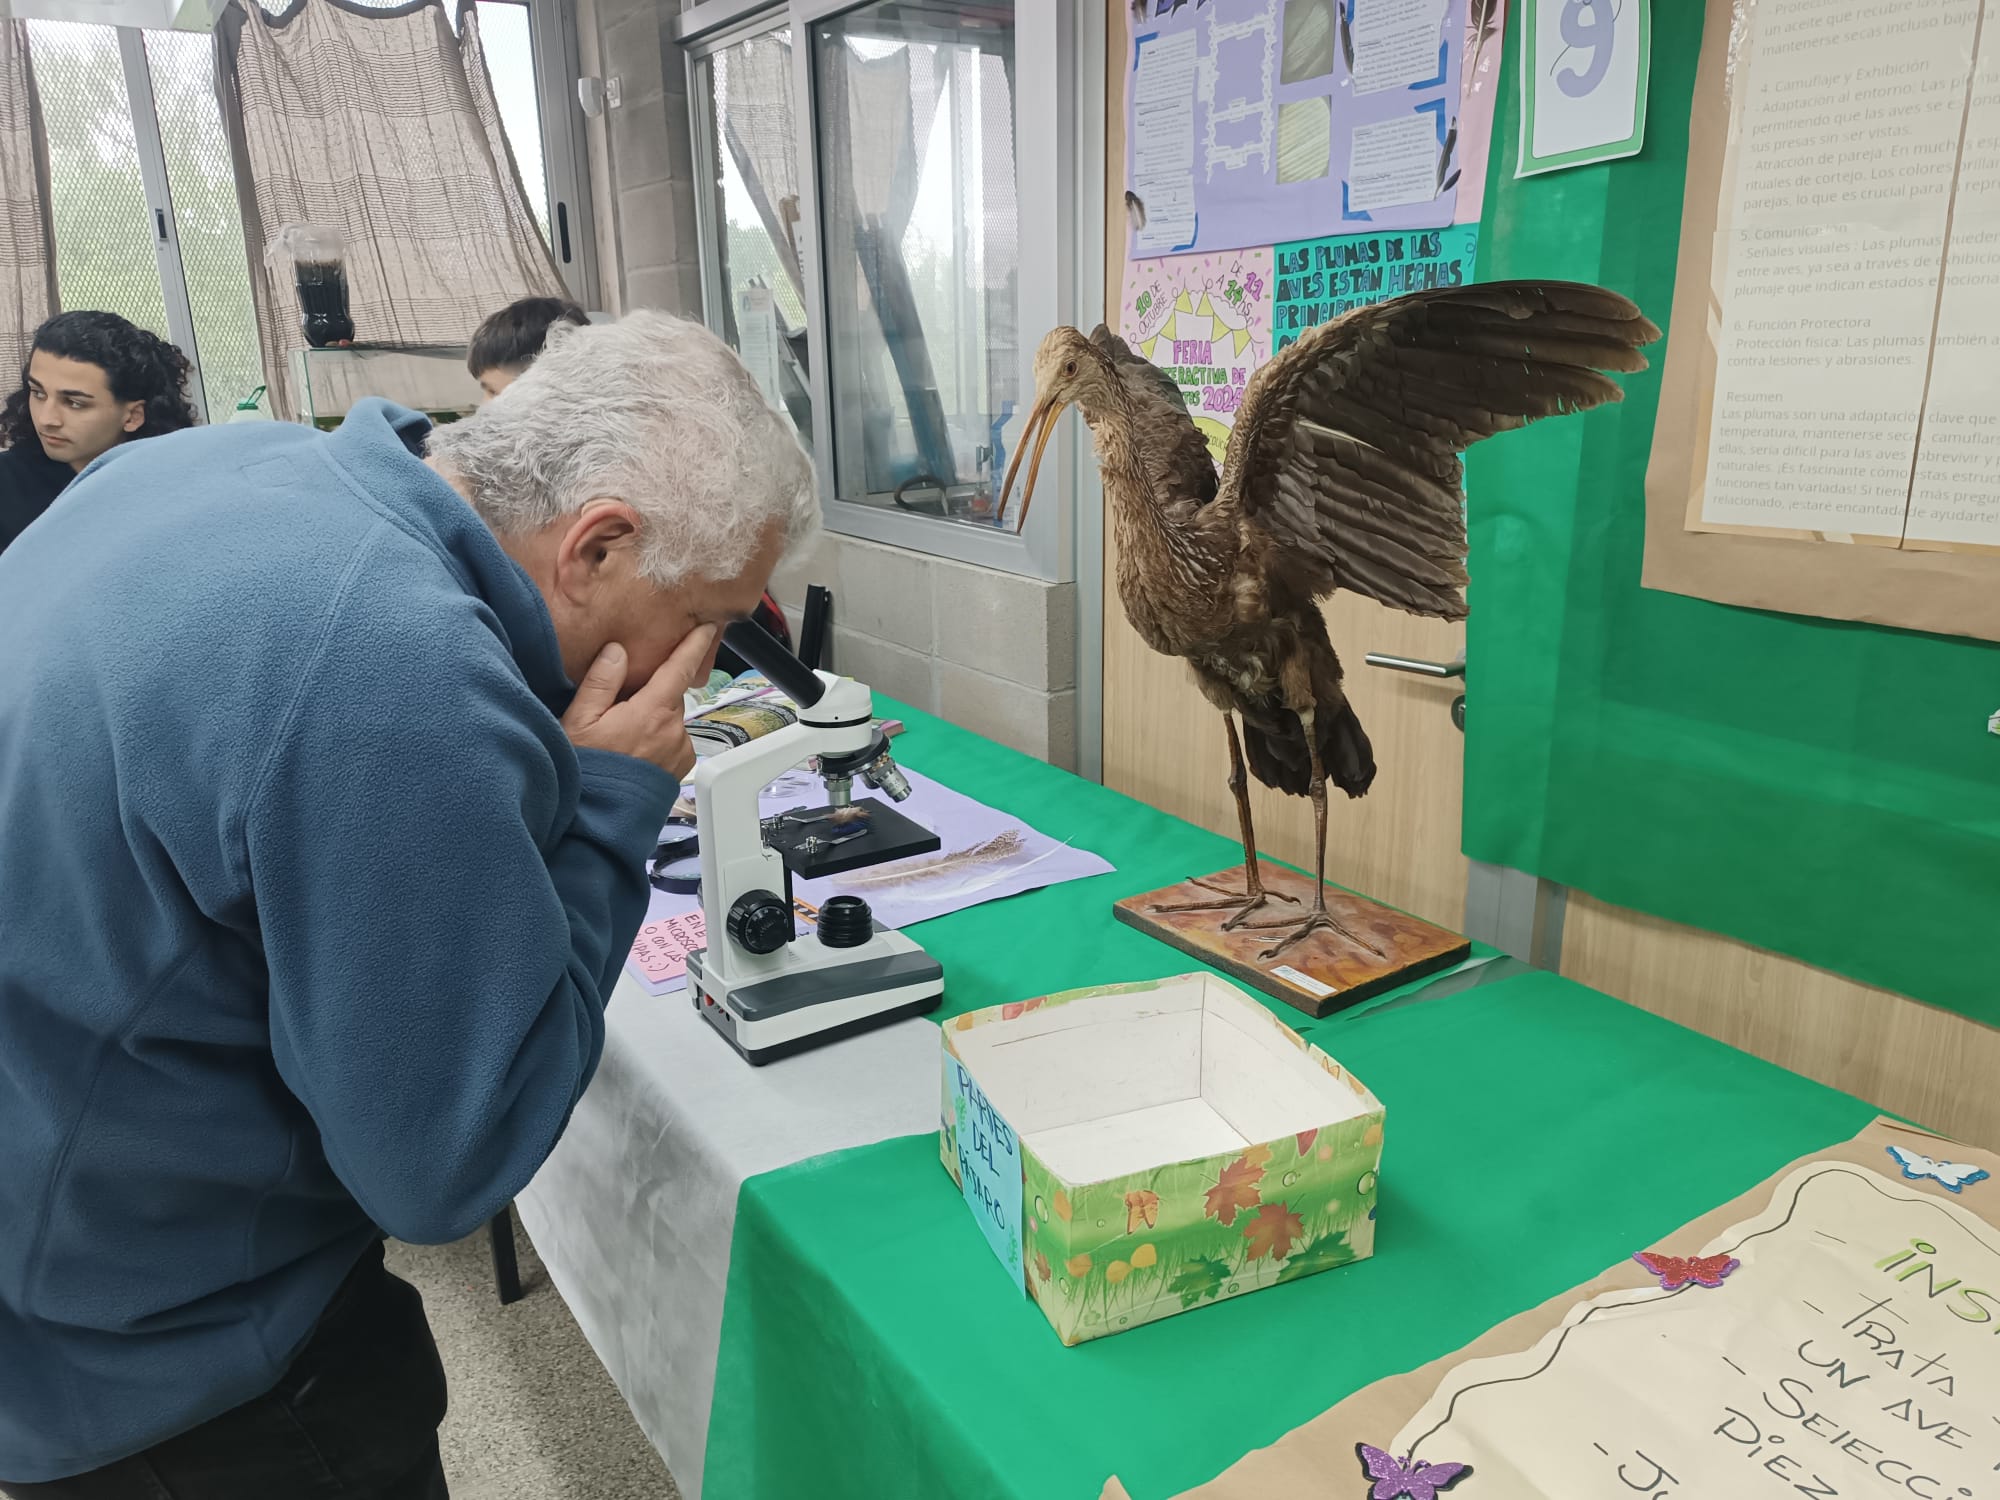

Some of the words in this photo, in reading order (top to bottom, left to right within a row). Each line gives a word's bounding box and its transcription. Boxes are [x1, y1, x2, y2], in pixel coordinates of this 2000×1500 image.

[1826, 10, 1852, 27] que
[1762, 33, 1840, 56] mantenerse
[1921, 79, 1945, 92] Las
[1834, 111, 1860, 126] que
[1865, 107, 1885, 120] las
[1818, 152, 1834, 165] de
[1891, 145, 1909, 157] En
[1795, 174, 1811, 186] de
[1871, 168, 1895, 180] Los
[1812, 192, 1837, 206] que
[1910, 183, 1944, 199] para
[1278, 248, 1309, 275] LAS
[1315, 239, 1380, 270] PLUMAS
[1385, 238, 1403, 262] DE
[1411, 232, 1442, 260] LAS
[1862, 239, 1886, 251] Las
[1230, 260, 1243, 278] DE
[1913, 255, 1931, 267] de
[1276, 272, 1325, 302] AVES
[1329, 265, 1383, 297] ESTÁN
[1388, 259, 1463, 293] HECHAS
[1135, 290, 1153, 318] 10
[1149, 279, 1162, 298] DE
[1734, 283, 1784, 299] plumaje
[1787, 282, 1812, 296] que
[1138, 293, 1168, 335] OCTUBRE
[1800, 317, 1872, 329] Protectora
[1846, 335, 1870, 348] Las
[1872, 334, 1925, 349] plumas
[1173, 340, 1213, 365] FERIA
[1231, 367, 1246, 385] DE
[1726, 391, 1784, 403] Resumen
[1721, 408, 1741, 420] Las
[1744, 408, 1789, 422] plumas
[1820, 410, 1846, 421] una
[1928, 411, 1965, 425] clave
[1969, 414, 1997, 427] que
[1820, 447, 1850, 460] para
[1774, 480, 1795, 491] tan
[956, 1063, 1013, 1156] PARTES
[972, 1119, 1000, 1177] DEL
[1841, 1292, 1955, 1397] TRATA
[1797, 1339, 1871, 1389] UN
[1881, 1398, 1972, 1449] AVE
